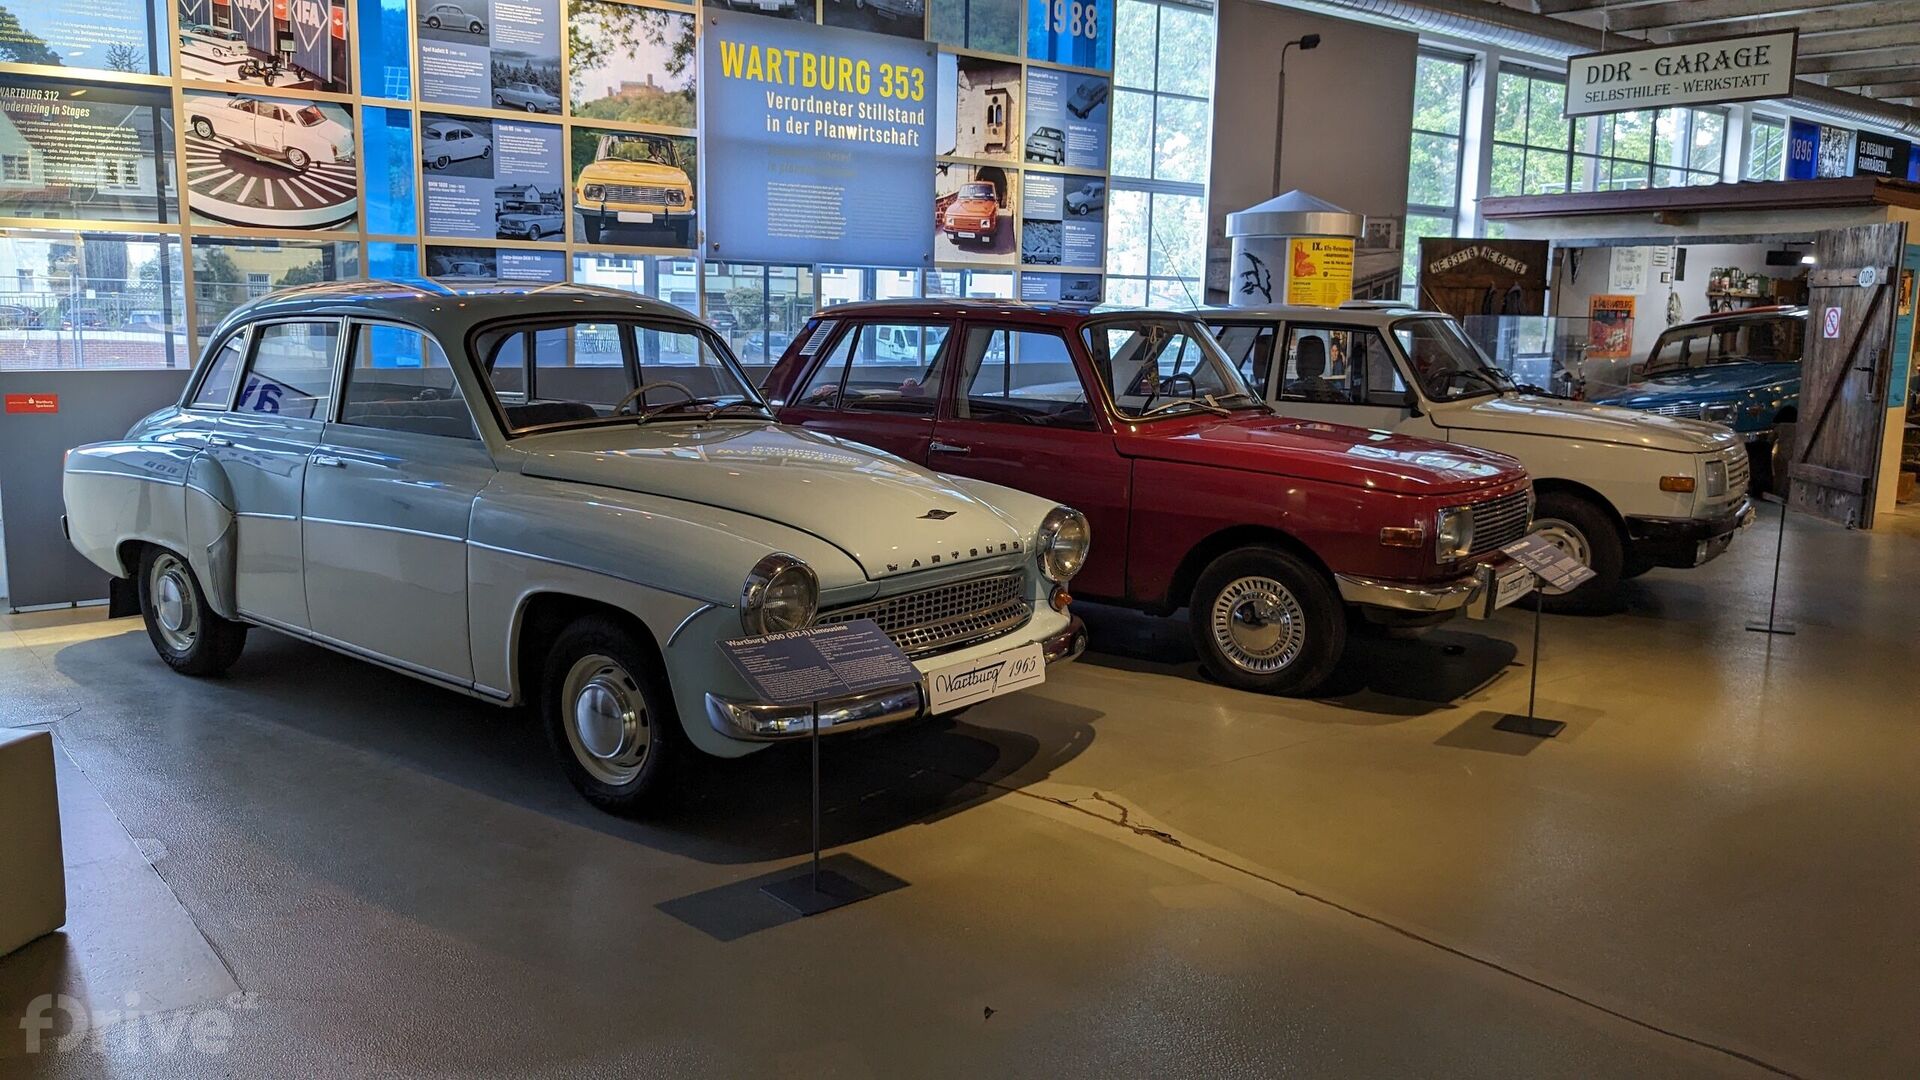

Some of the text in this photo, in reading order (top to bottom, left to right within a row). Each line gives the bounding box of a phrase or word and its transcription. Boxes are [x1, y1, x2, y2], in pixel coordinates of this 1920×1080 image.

[1041, 0, 1097, 39] 1988
[720, 40, 925, 102] WARTBURG 353
[1585, 61, 1632, 85] DDR
[1655, 45, 1772, 76] GARAGE
[43, 90, 59, 101] 312
[1584, 83, 1670, 104] SELBSTHILFE
[1683, 73, 1770, 94] WERKSTATT
[51, 104, 60, 114] in
[62, 105, 90, 119] Stages
[766, 91, 925, 126] Verordneter Stillstand
[766, 115, 920, 147] in der Planwirtschaft
[1791, 138, 1812, 162] 1896
[1860, 141, 1894, 159] ES BEGANN MIT
[1312, 242, 1323, 251] IX.
[1860, 270, 1874, 284] DDR
[886, 542, 1020, 572] WARTBURG
[726, 636, 767, 647] Wartburg
[767, 633, 786, 642] 1000
[810, 624, 848, 636] Limousine
[936, 656, 1036, 693] Wartburg 1965
